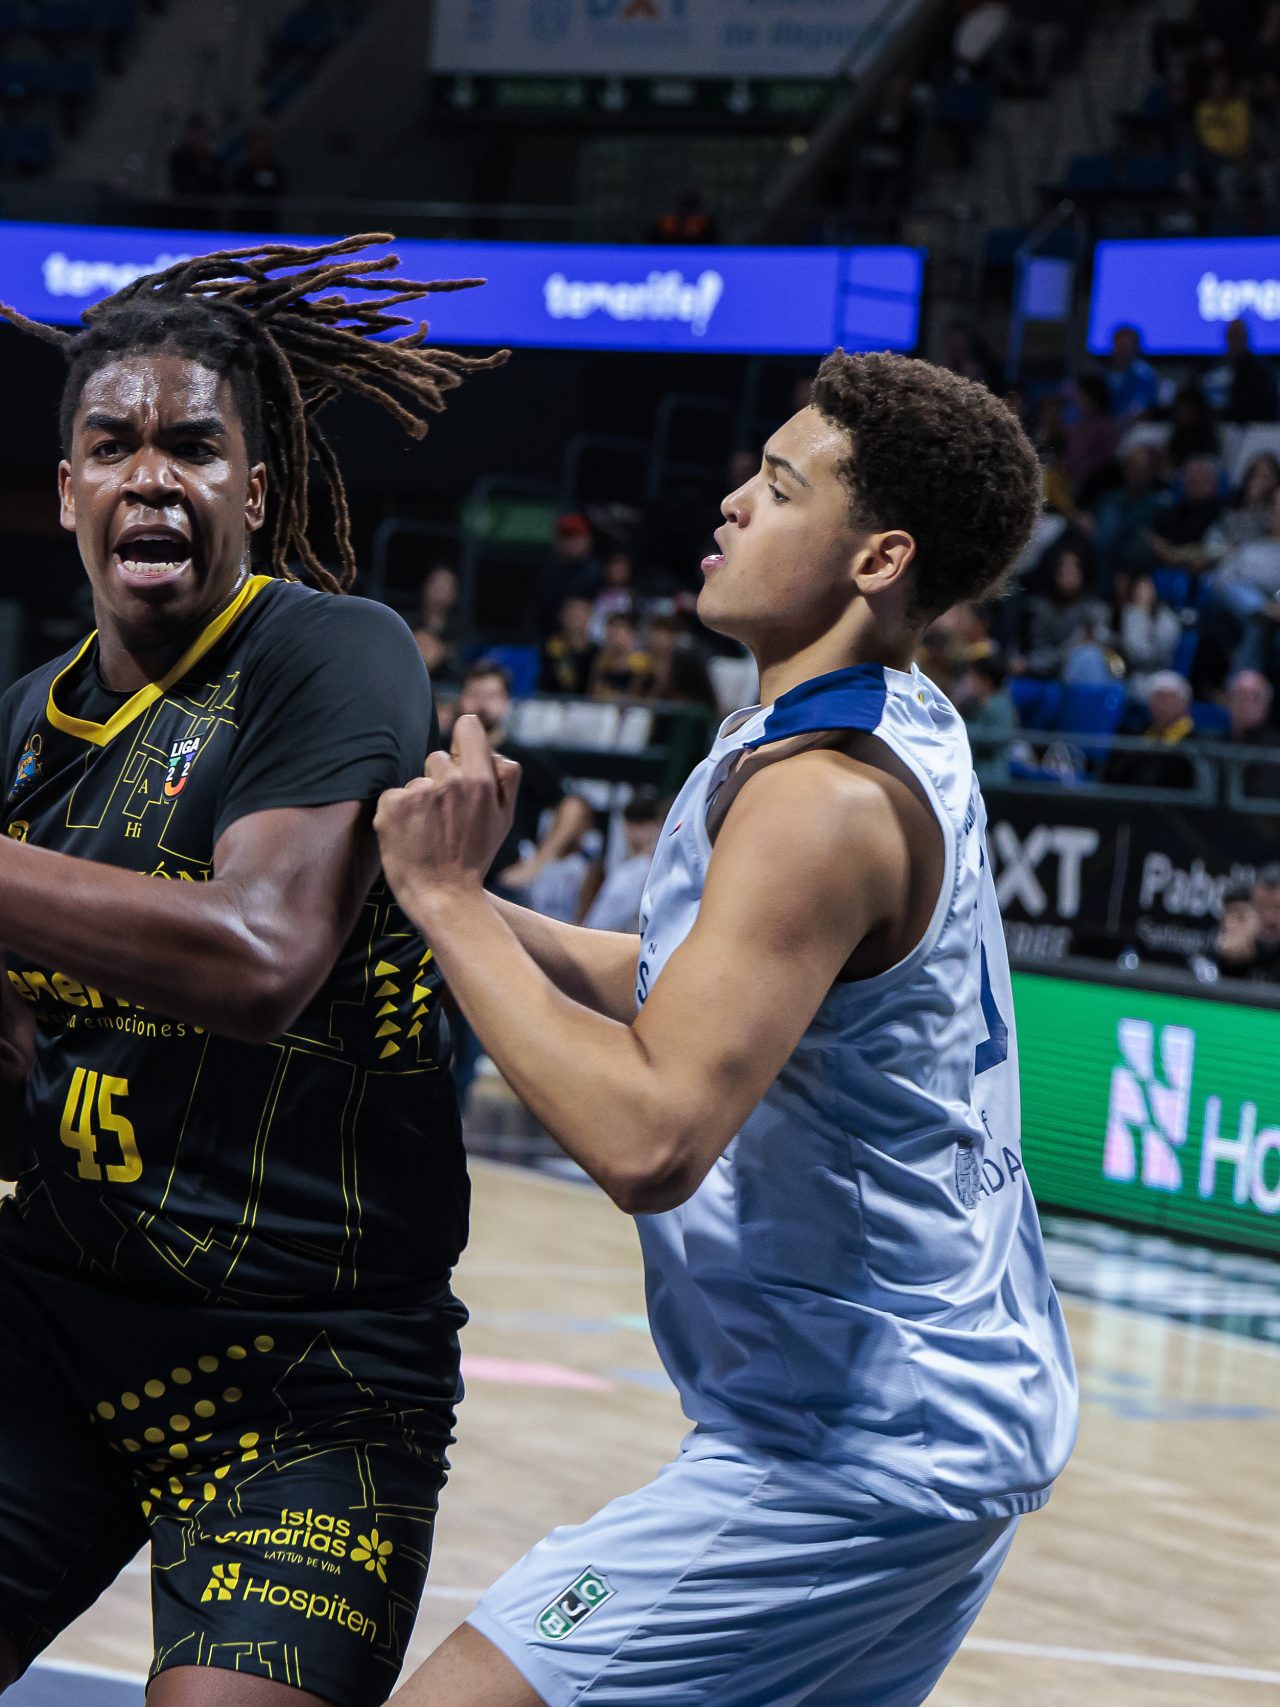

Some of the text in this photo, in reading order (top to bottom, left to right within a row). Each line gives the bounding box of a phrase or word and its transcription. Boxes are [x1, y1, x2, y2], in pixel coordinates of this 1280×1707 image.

[171, 738, 200, 757] LIGA
[137, 779, 149, 794] A
[124, 821, 142, 838] Hi
[986, 820, 1100, 918] XT
[84, 1014, 186, 1038] emociones
[59, 1066, 143, 1183] 45
[264, 1550, 341, 1576] LATITUD DE VIDA
[242, 1577, 377, 1643] Hospiten
